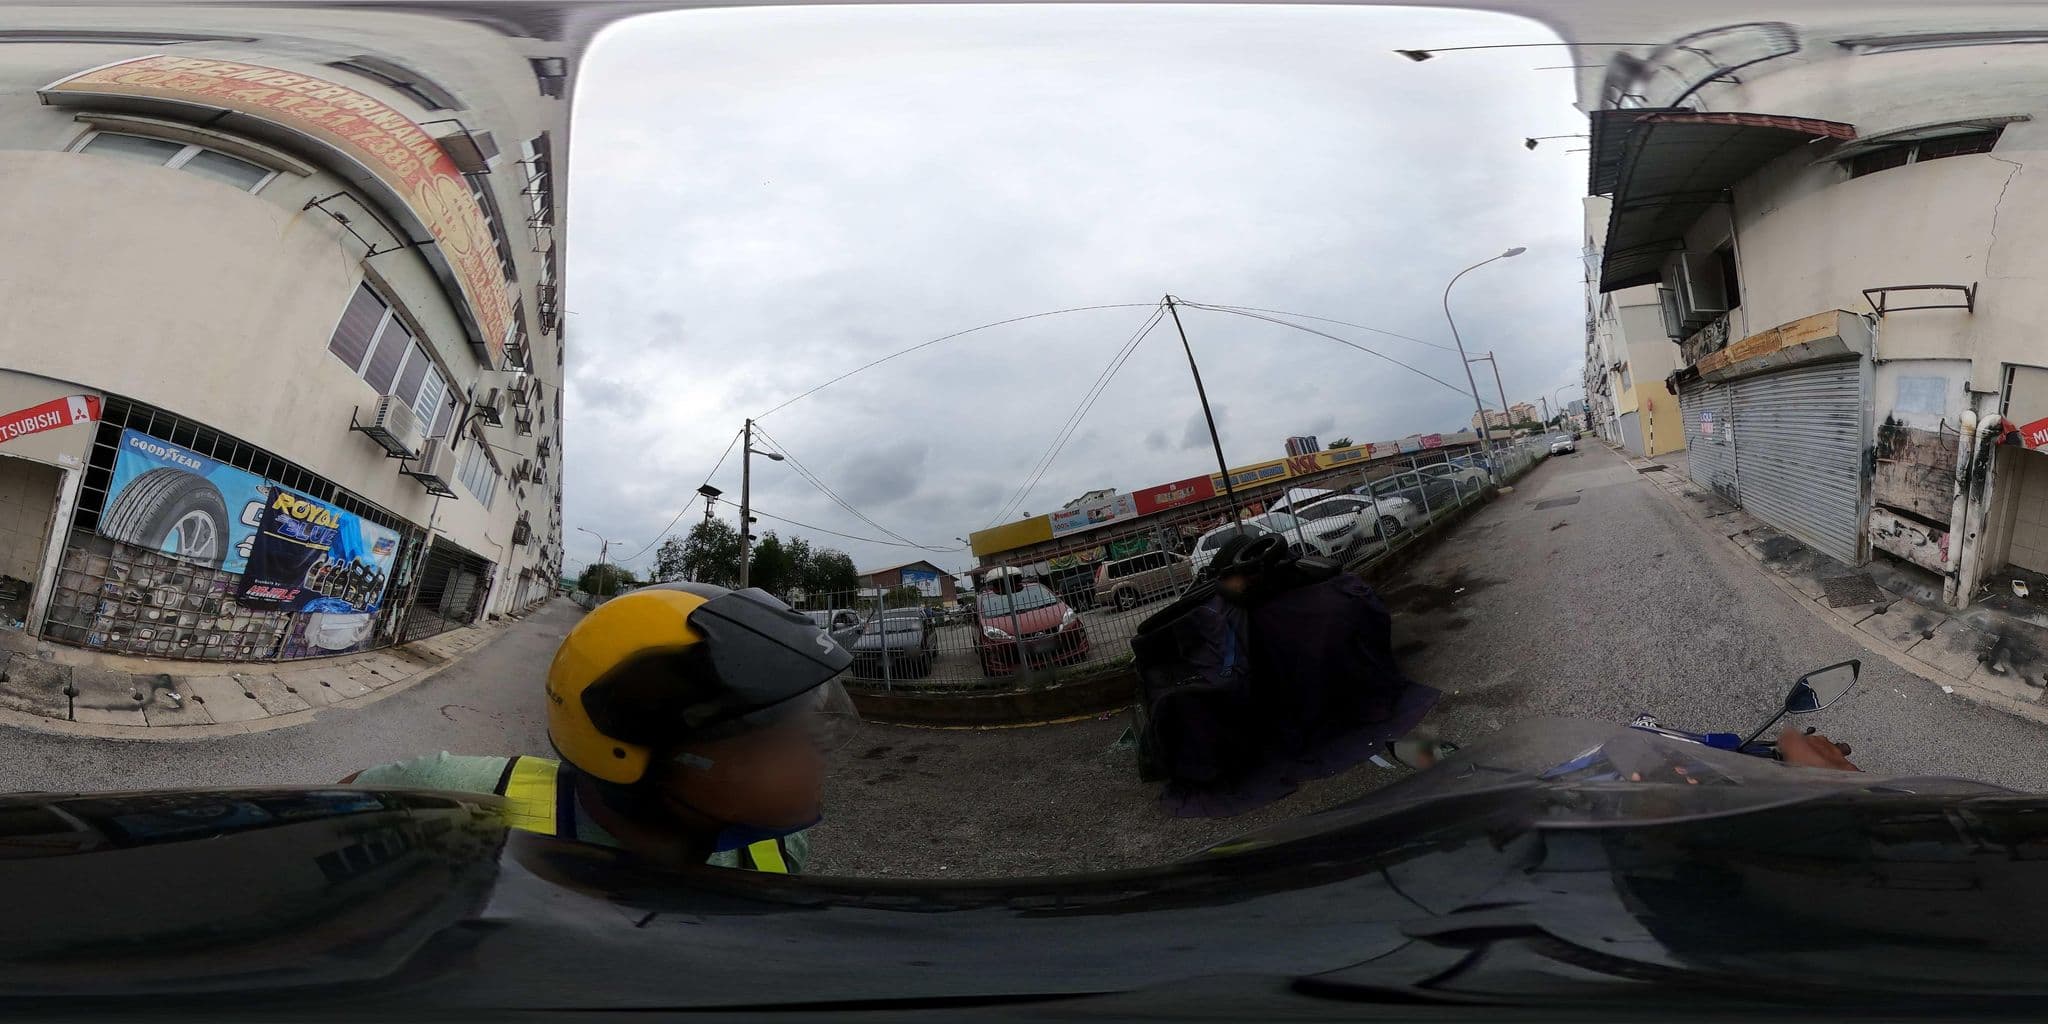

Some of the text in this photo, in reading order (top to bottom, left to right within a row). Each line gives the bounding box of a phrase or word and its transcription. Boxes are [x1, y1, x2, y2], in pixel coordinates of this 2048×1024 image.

[342, 93, 445, 170] PINJAMAN
[129, 437, 202, 470] GOODYEAR
[1287, 454, 1322, 476] NSK
[272, 492, 340, 529] ROYAL
[276, 517, 338, 545] BLUE
